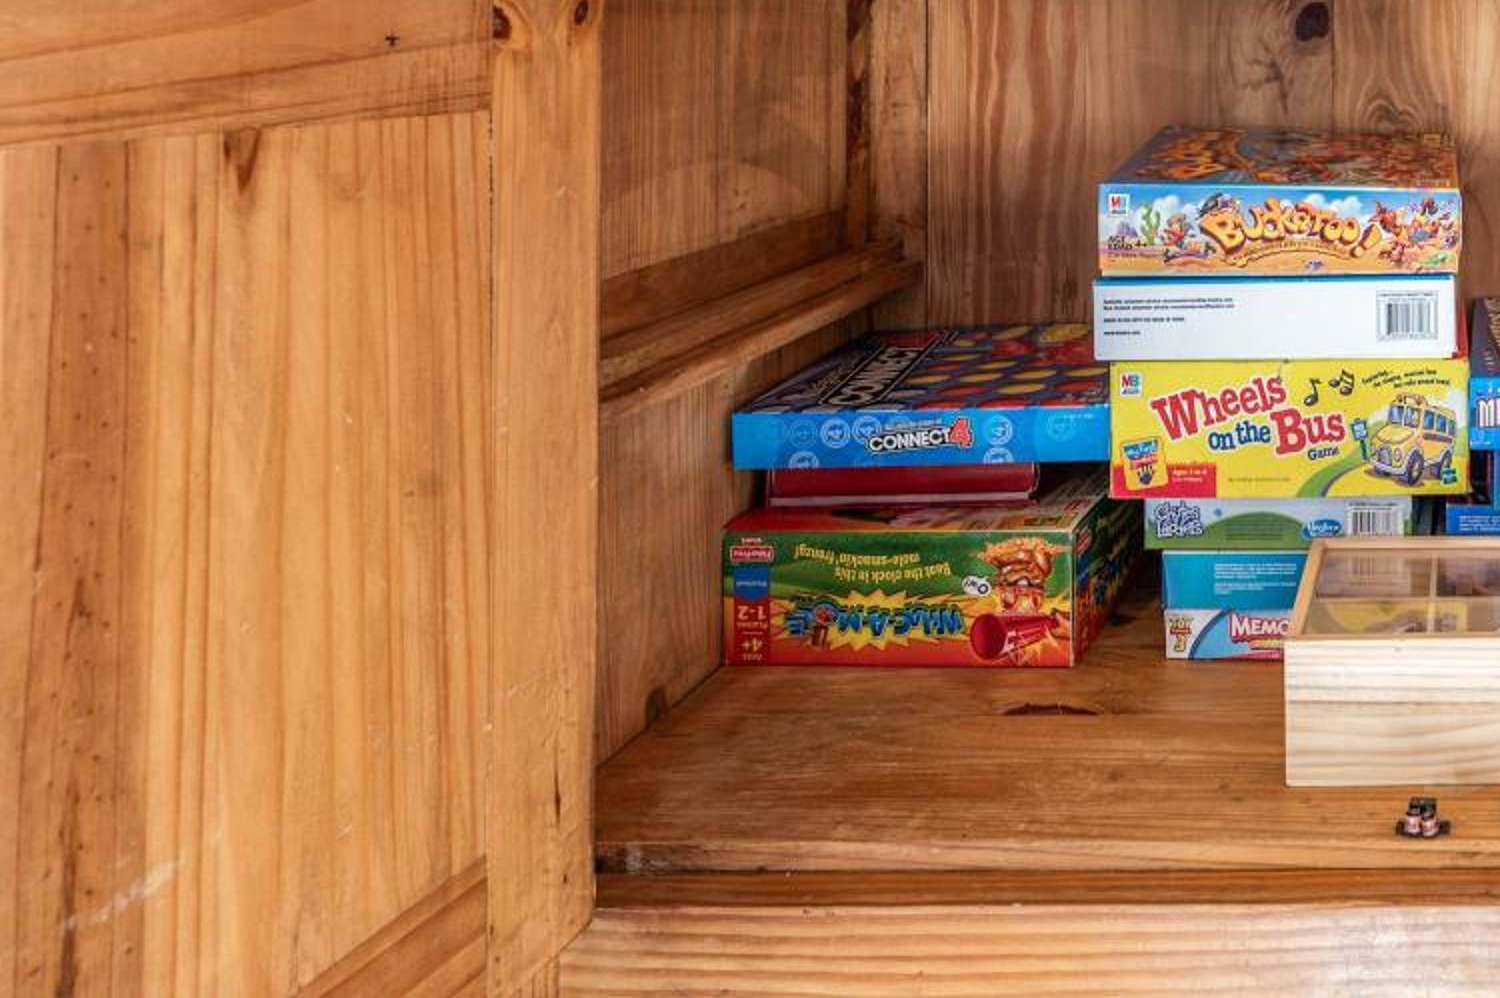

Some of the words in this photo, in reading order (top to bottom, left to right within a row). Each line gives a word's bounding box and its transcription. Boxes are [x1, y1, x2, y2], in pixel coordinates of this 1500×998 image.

[1199, 197, 1383, 258] Buckaroo!
[1121, 375, 1140, 387] MB
[1150, 377, 1287, 441] Wheels
[869, 428, 951, 451] CONNECT
[950, 417, 972, 448] 4
[1208, 431, 1236, 450] on
[1236, 420, 1271, 445] the
[1270, 408, 1346, 455] Bus
[871, 568, 901, 583] clock
[904, 567, 923, 580] the
[737, 605, 767, 620] 1-2
[742, 637, 763, 652] 4+
